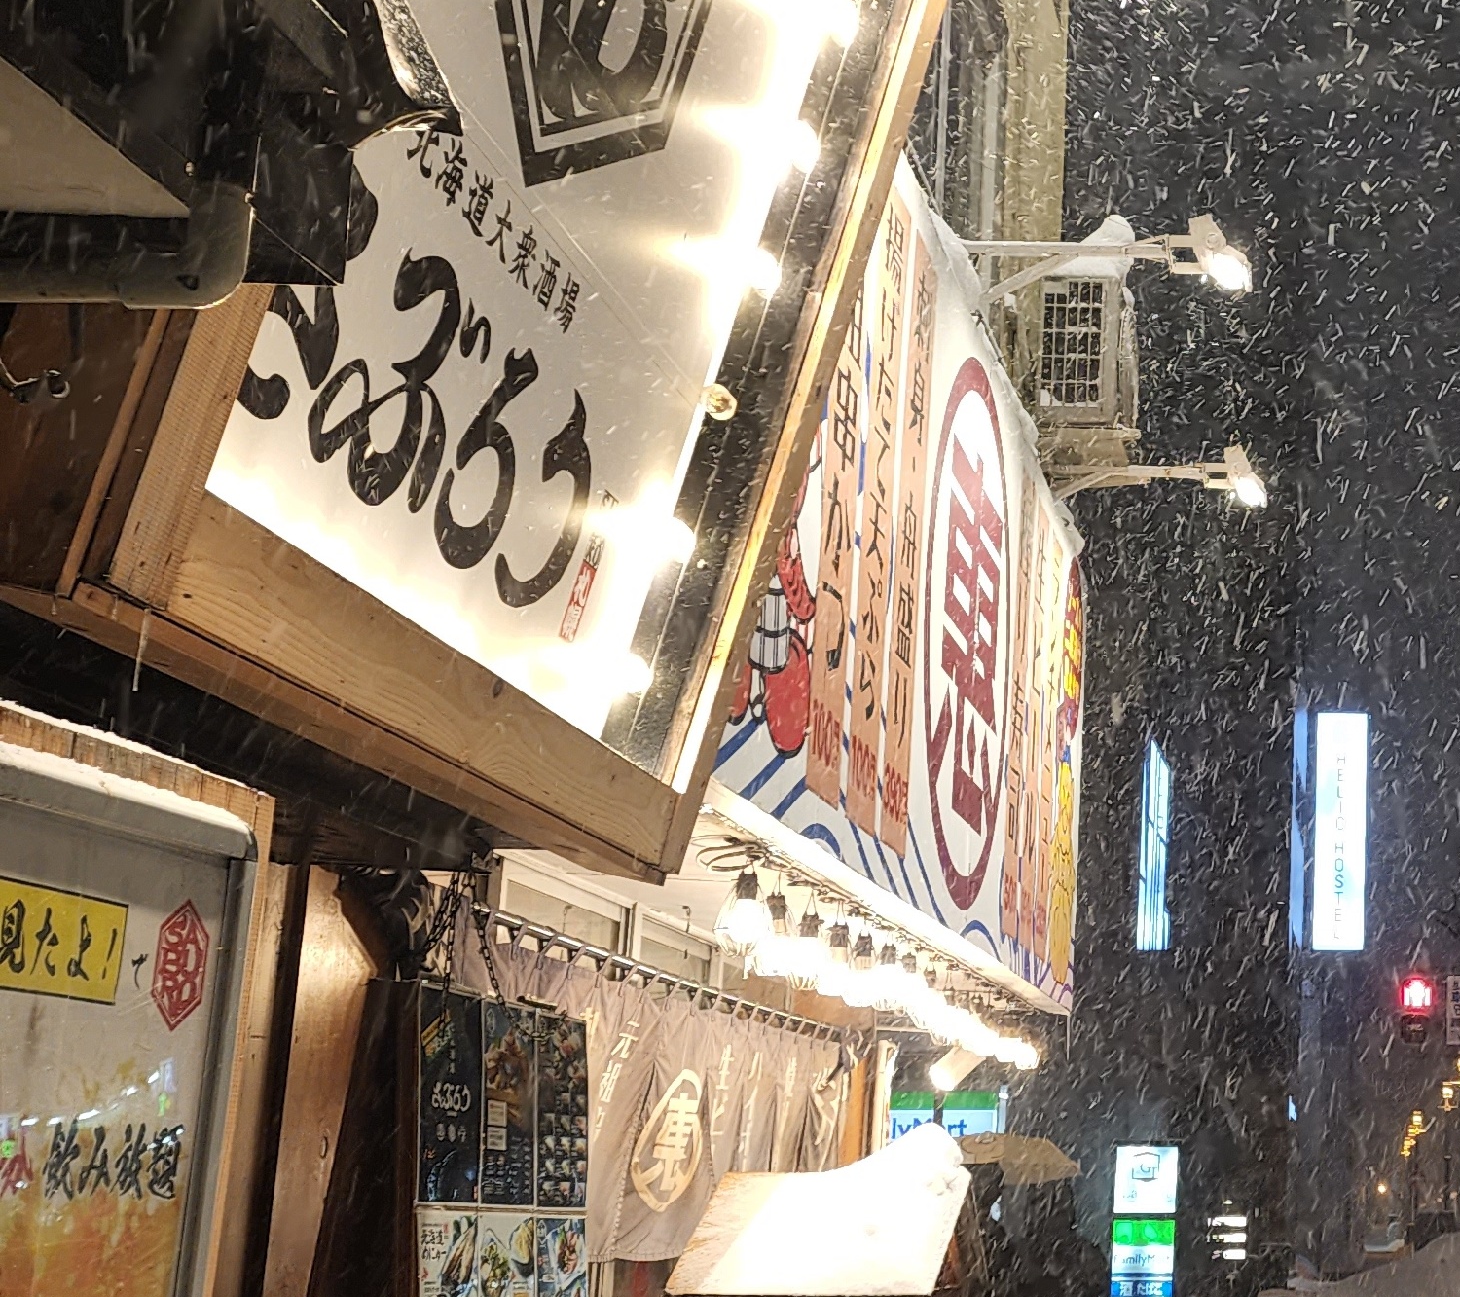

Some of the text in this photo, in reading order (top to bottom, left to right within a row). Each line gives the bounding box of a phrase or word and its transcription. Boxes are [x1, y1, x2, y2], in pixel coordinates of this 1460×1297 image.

[407, 130, 580, 334] 北海道大衆酒場
[857, 204, 905, 722] 揚げたて天ぷら
[1334, 843, 1344, 940] HOSTEL
[1114, 1253, 1170, 1266] FmilyMt
